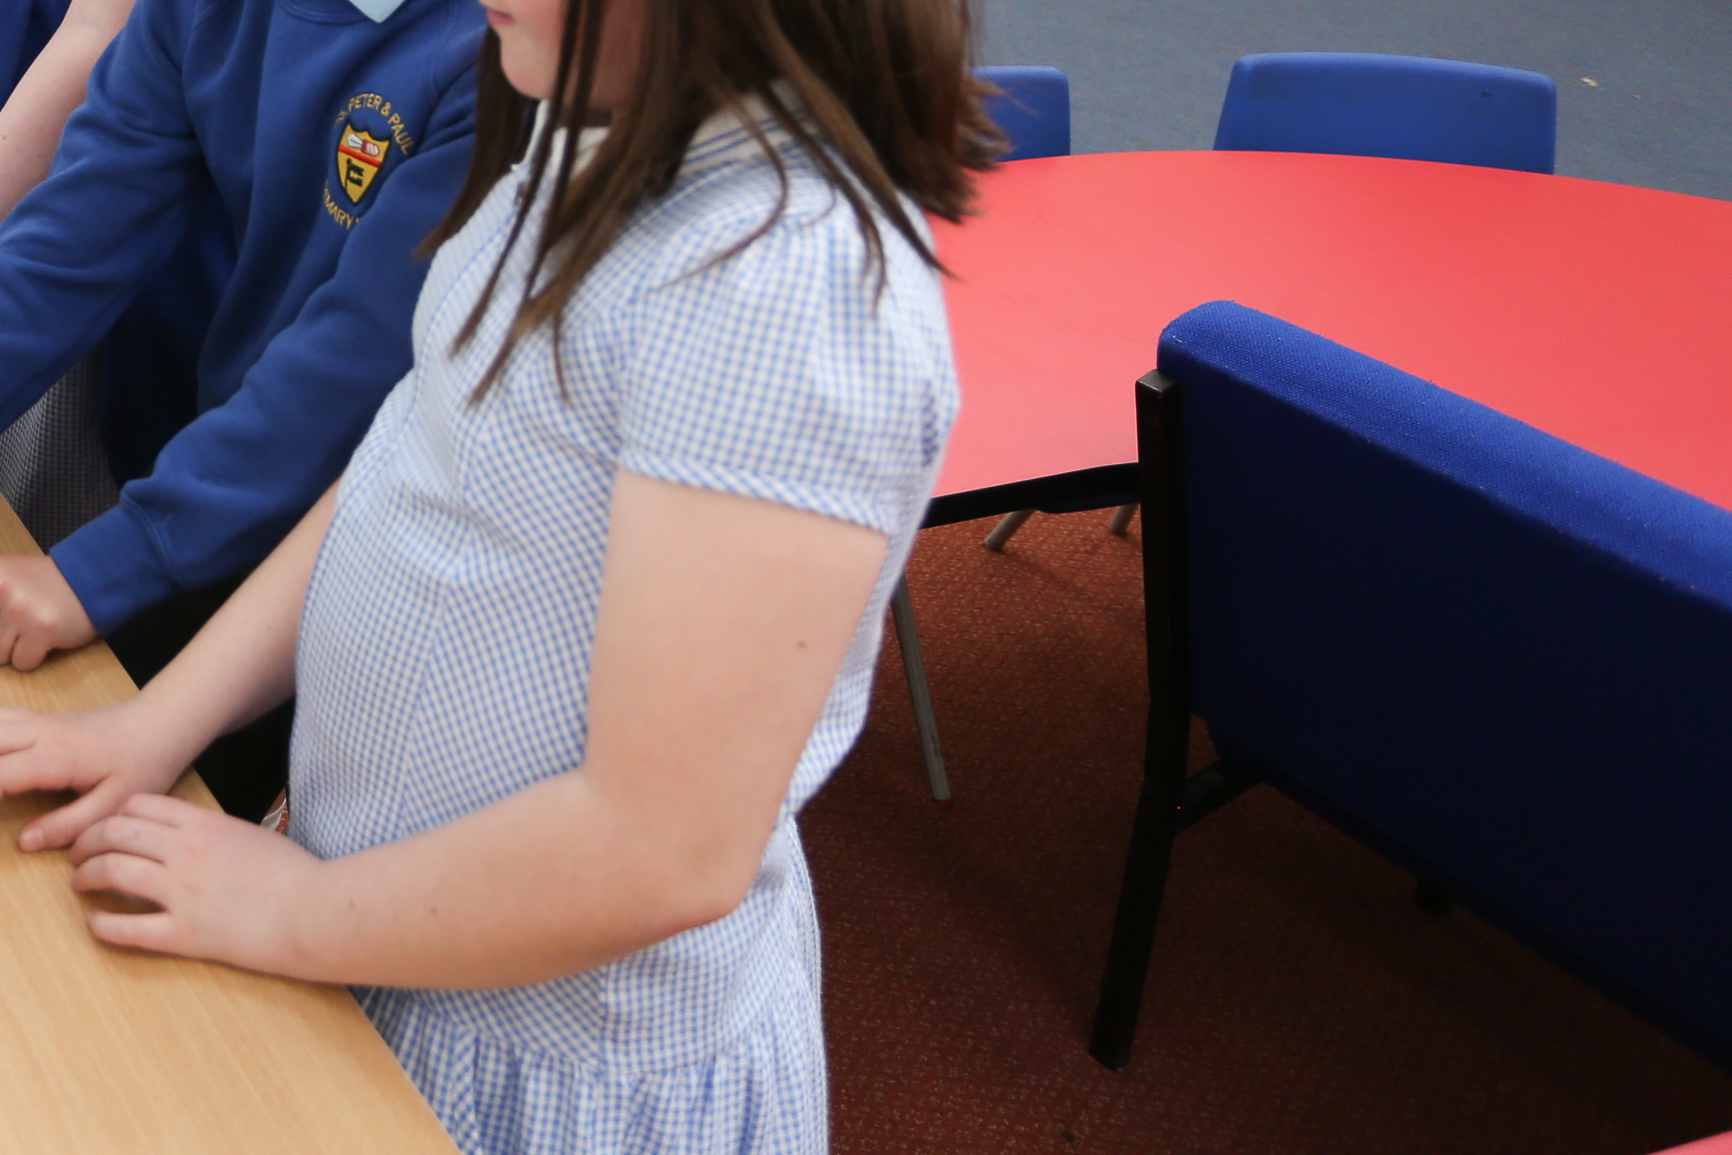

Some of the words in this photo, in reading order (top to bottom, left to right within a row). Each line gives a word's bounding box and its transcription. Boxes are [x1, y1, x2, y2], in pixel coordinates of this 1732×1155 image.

[348, 93, 383, 112] PETER
[381, 101, 392, 117] &
[387, 113, 415, 155] PAUL
